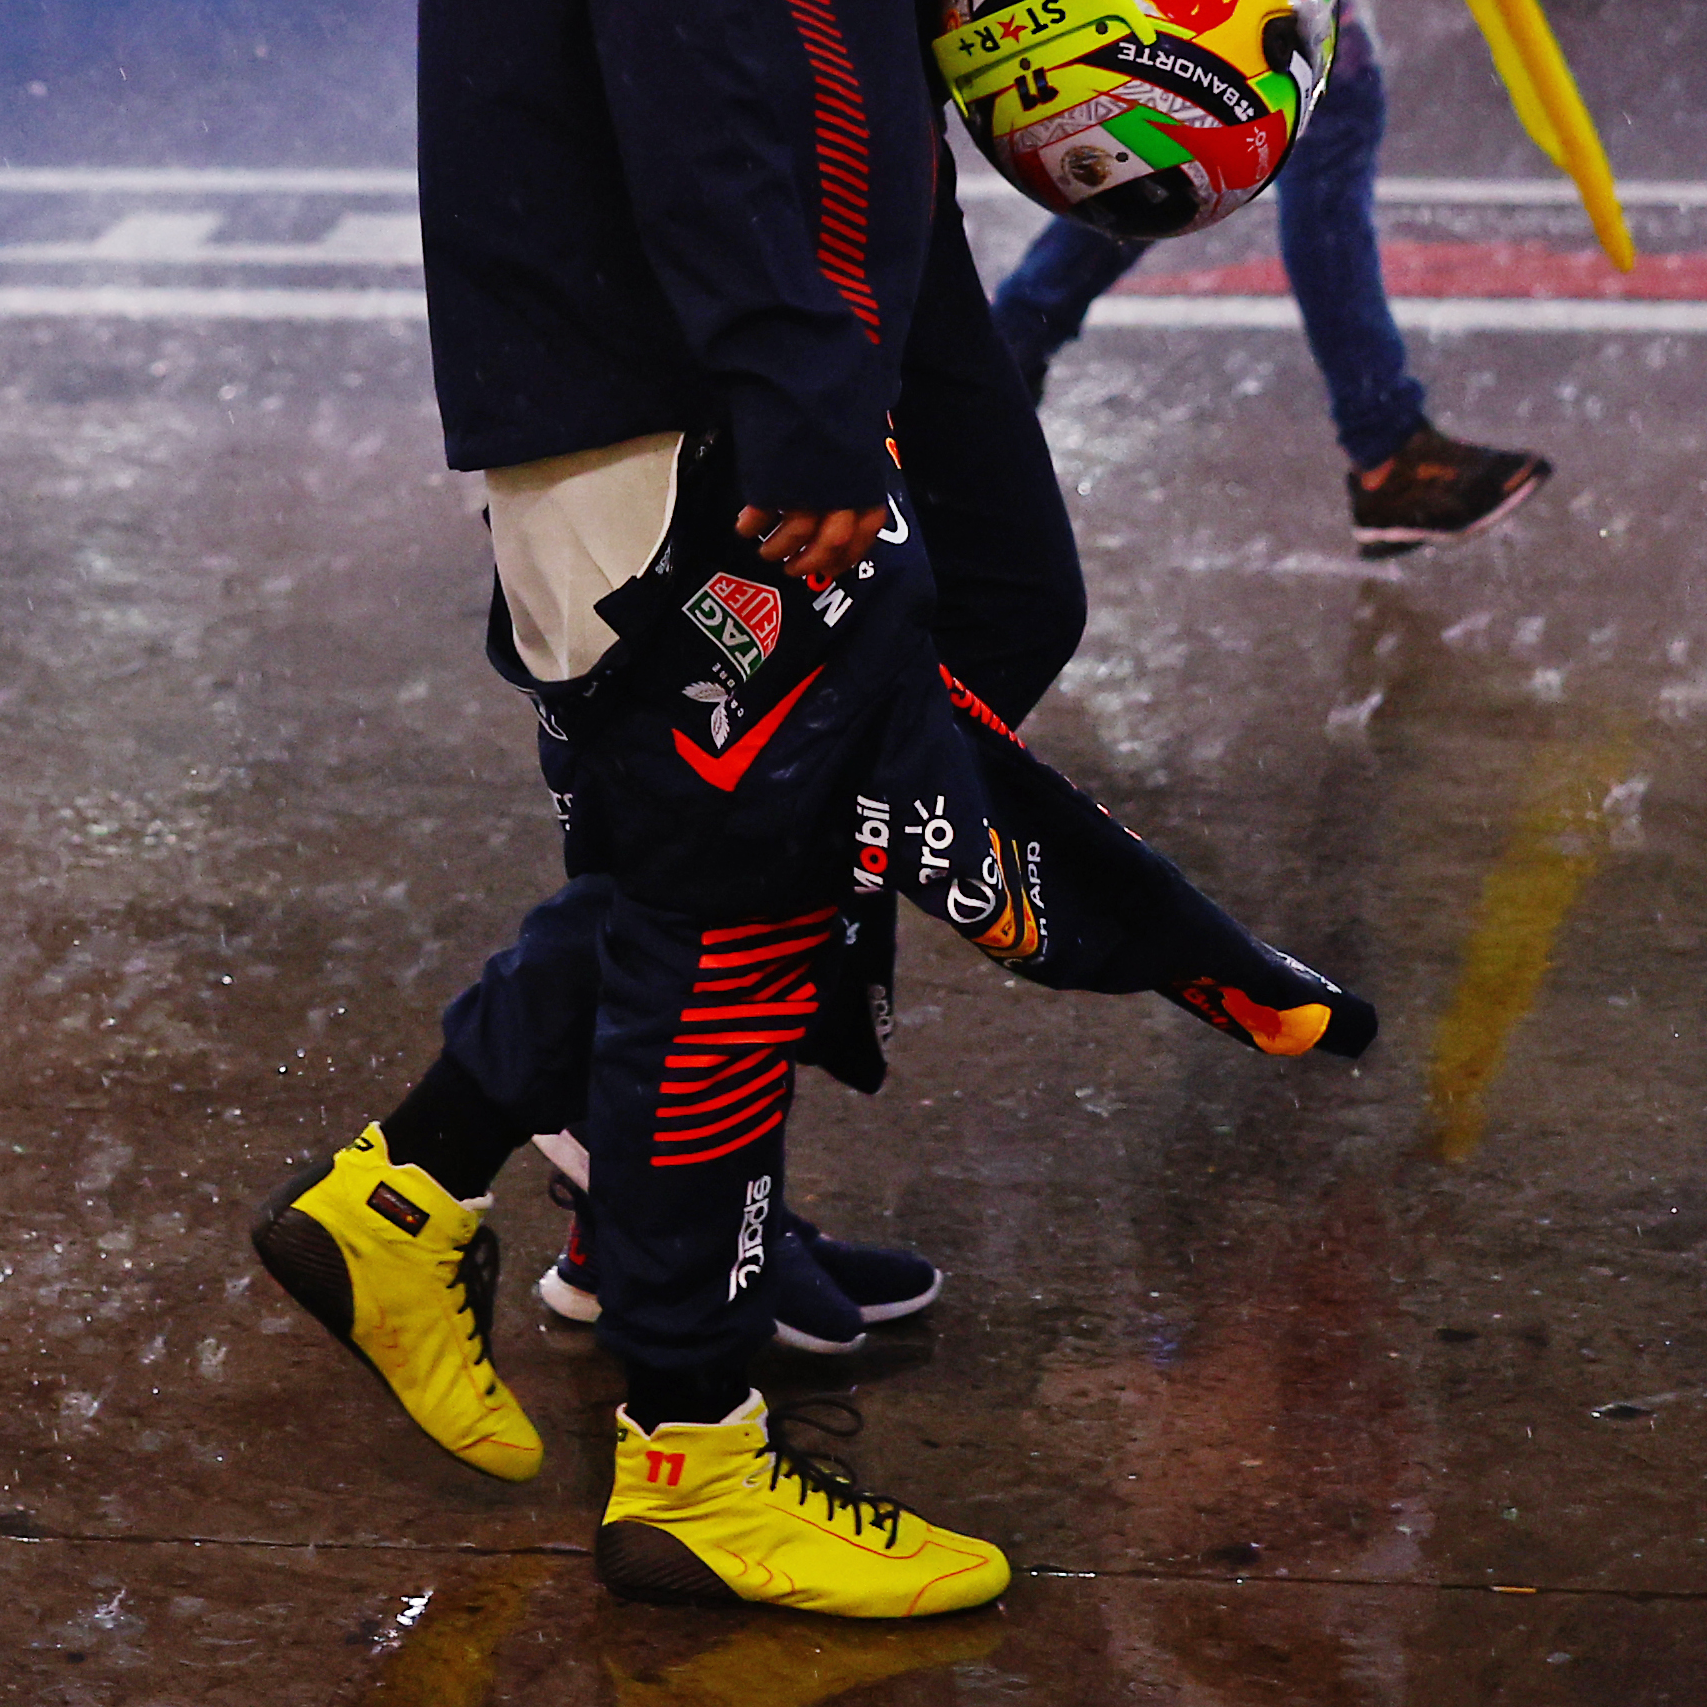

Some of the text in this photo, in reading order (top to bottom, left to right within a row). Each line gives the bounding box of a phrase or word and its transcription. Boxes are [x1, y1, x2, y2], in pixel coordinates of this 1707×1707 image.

[1013, 66, 1060, 112] 11
[1116, 40, 1246, 108] BANORTE
[694, 596, 760, 676] TAG
[714, 579, 778, 659] HEUER
[645, 1450, 686, 1487] 11
